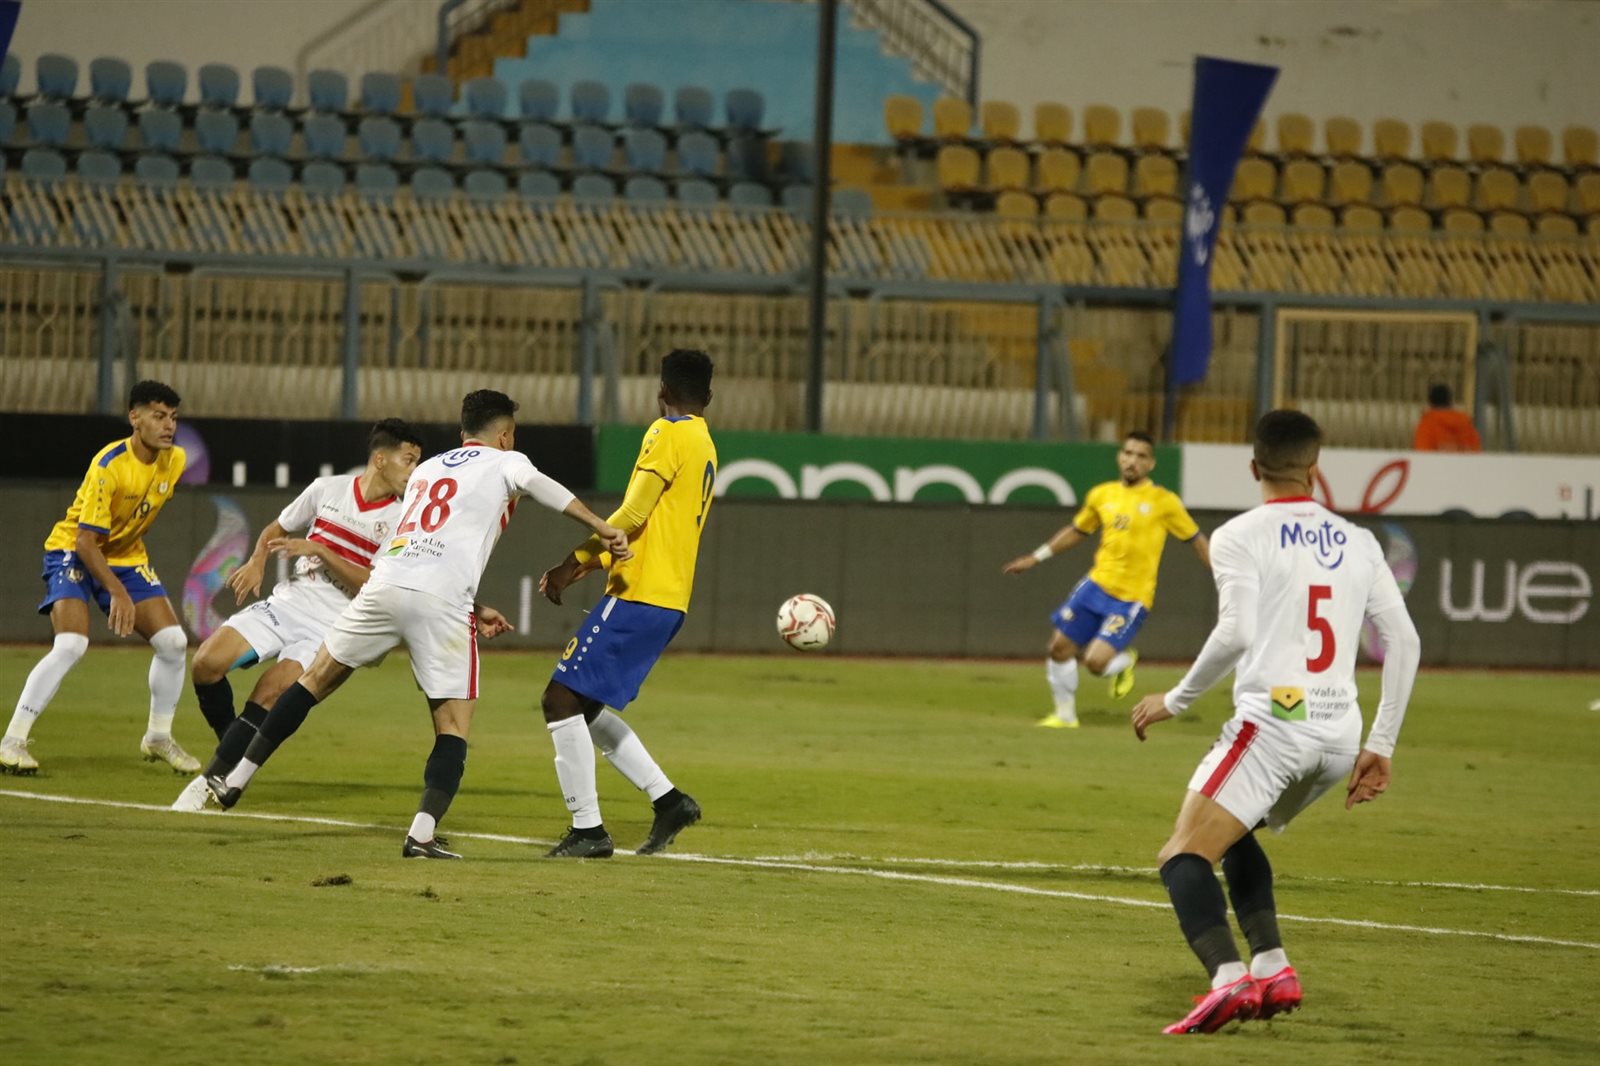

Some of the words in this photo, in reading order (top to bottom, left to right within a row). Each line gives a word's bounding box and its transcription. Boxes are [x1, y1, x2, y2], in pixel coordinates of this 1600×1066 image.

[397, 477, 459, 536] 28
[1280, 520, 1347, 557] Molto
[1440, 558, 1592, 623] we
[562, 636, 578, 661] 9
[1306, 584, 1336, 673] 5
